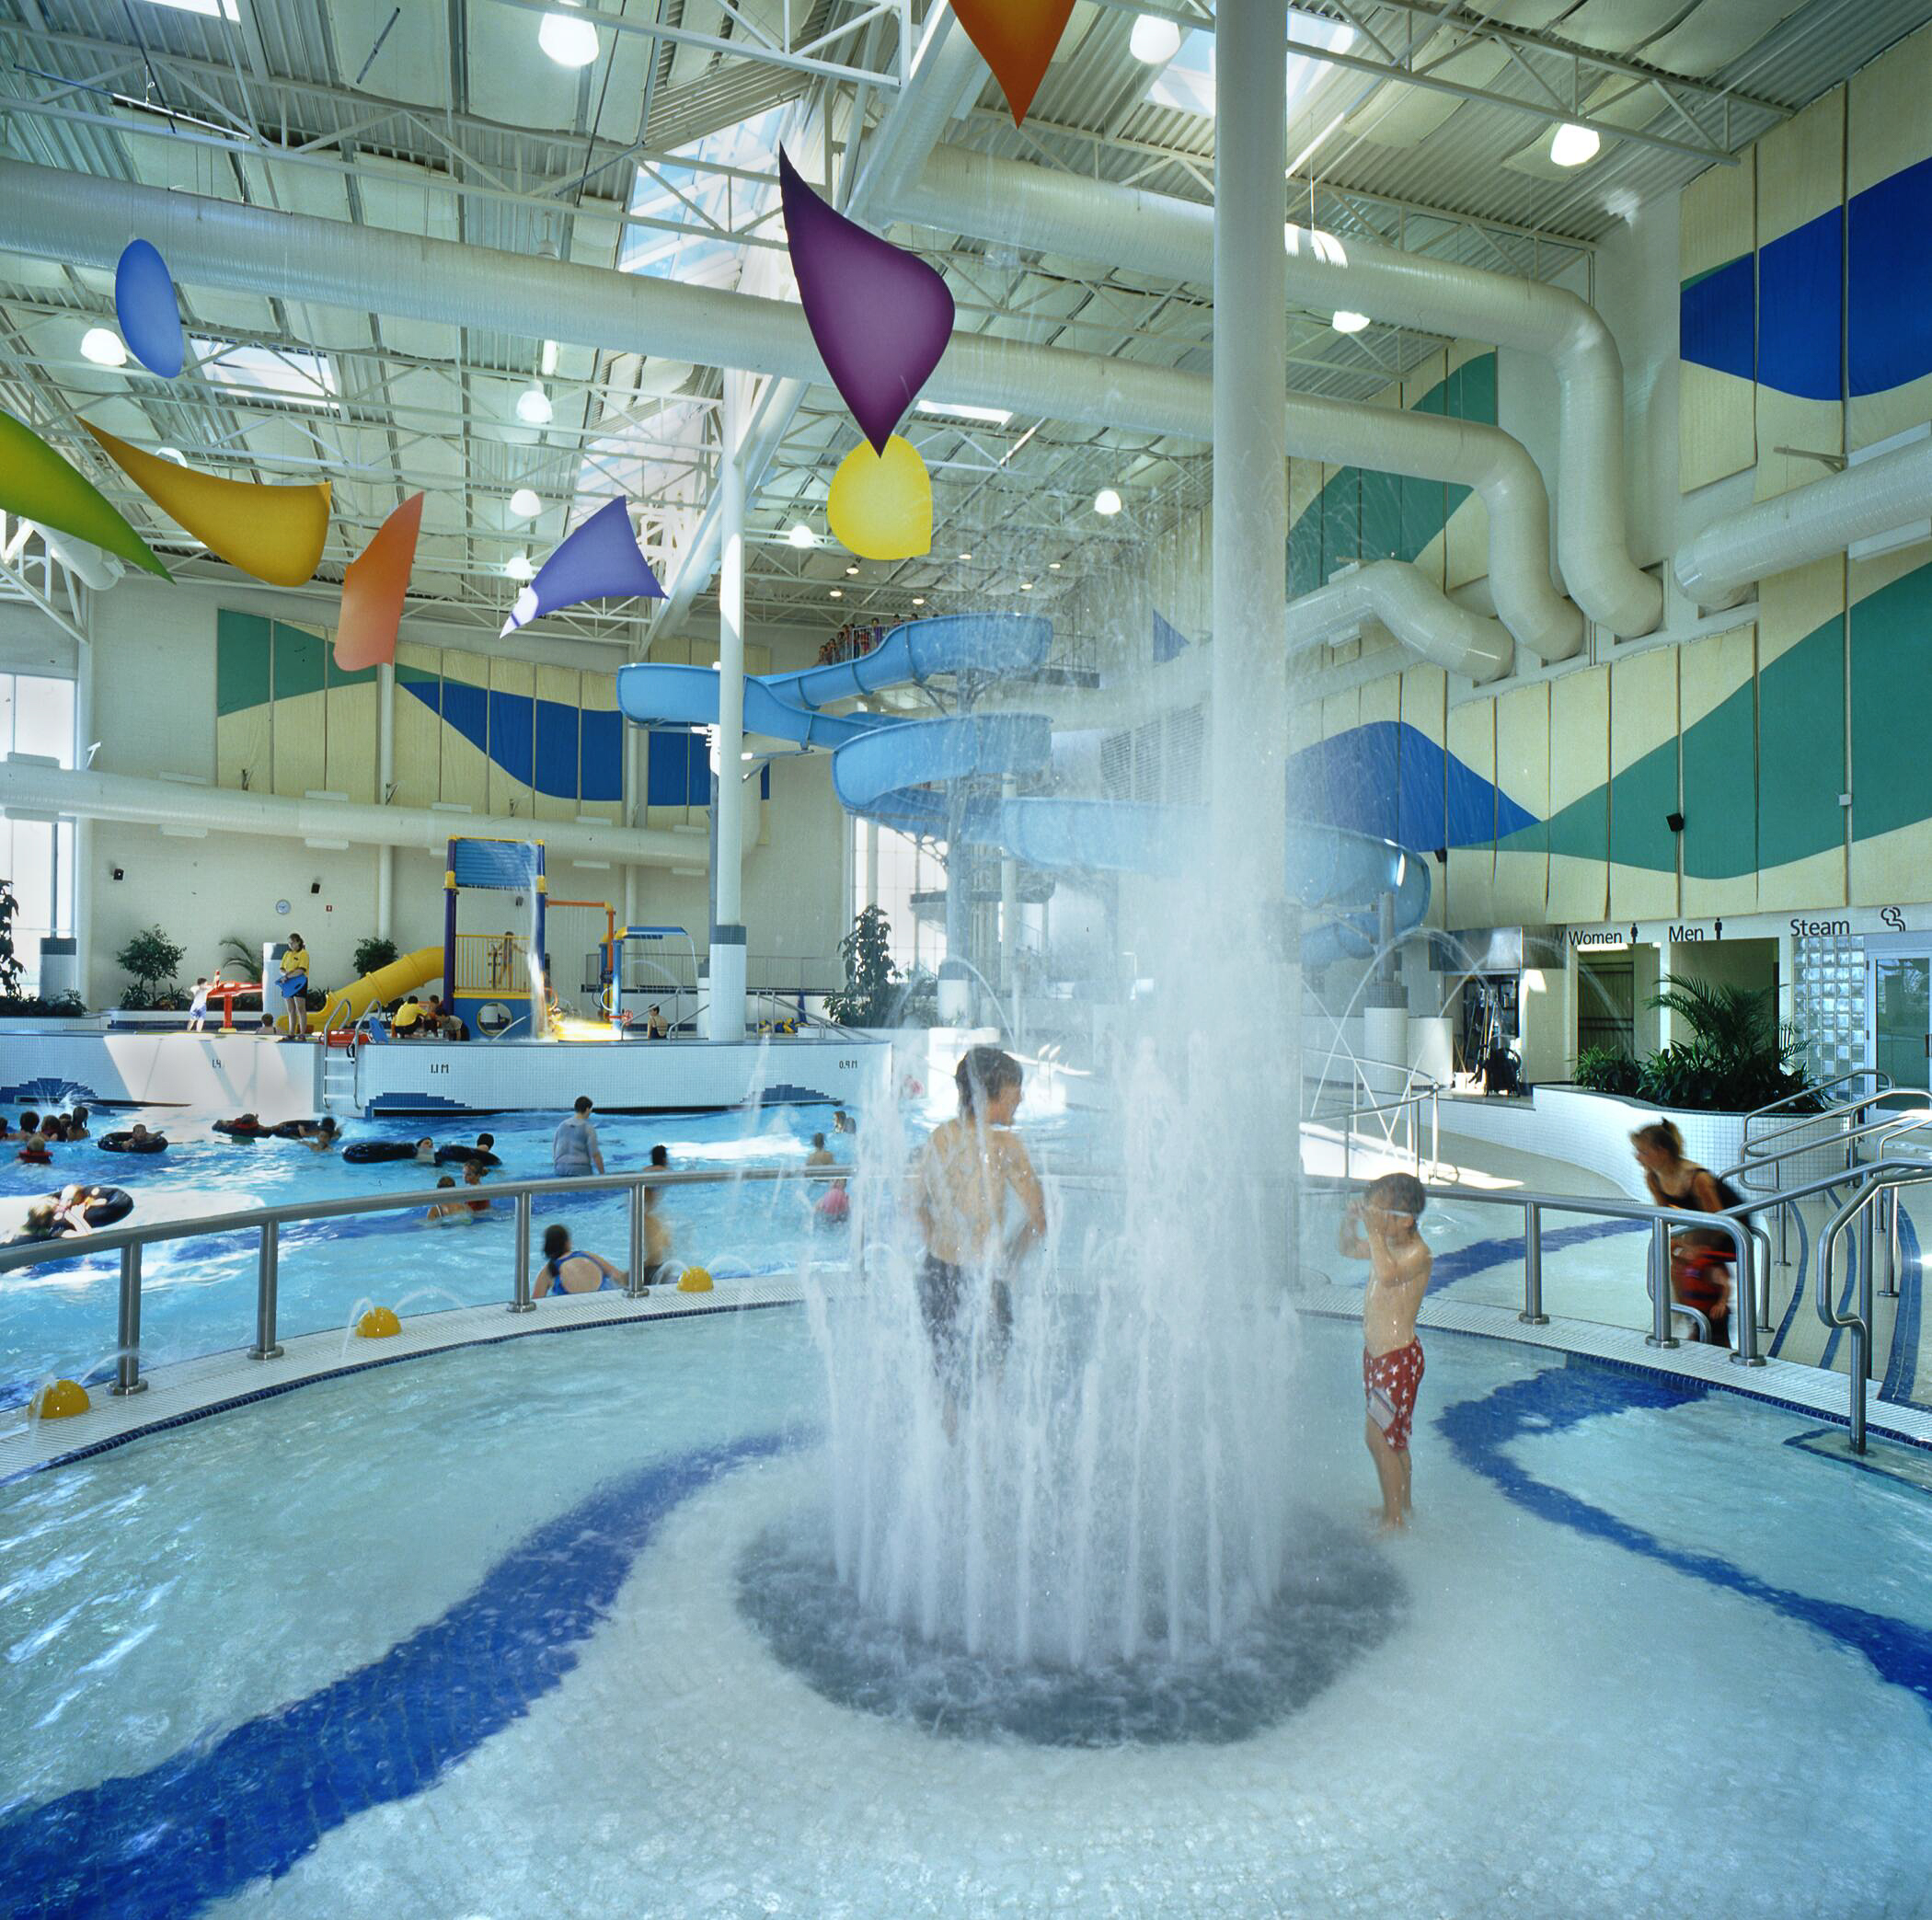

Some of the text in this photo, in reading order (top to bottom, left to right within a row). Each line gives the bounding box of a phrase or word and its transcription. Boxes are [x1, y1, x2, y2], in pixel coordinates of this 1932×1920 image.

[1669, 926, 1704, 942] Men
[1790, 919, 1850, 937] Steam
[1569, 930, 1623, 946] Women
[441, 1063, 449, 1074] M
